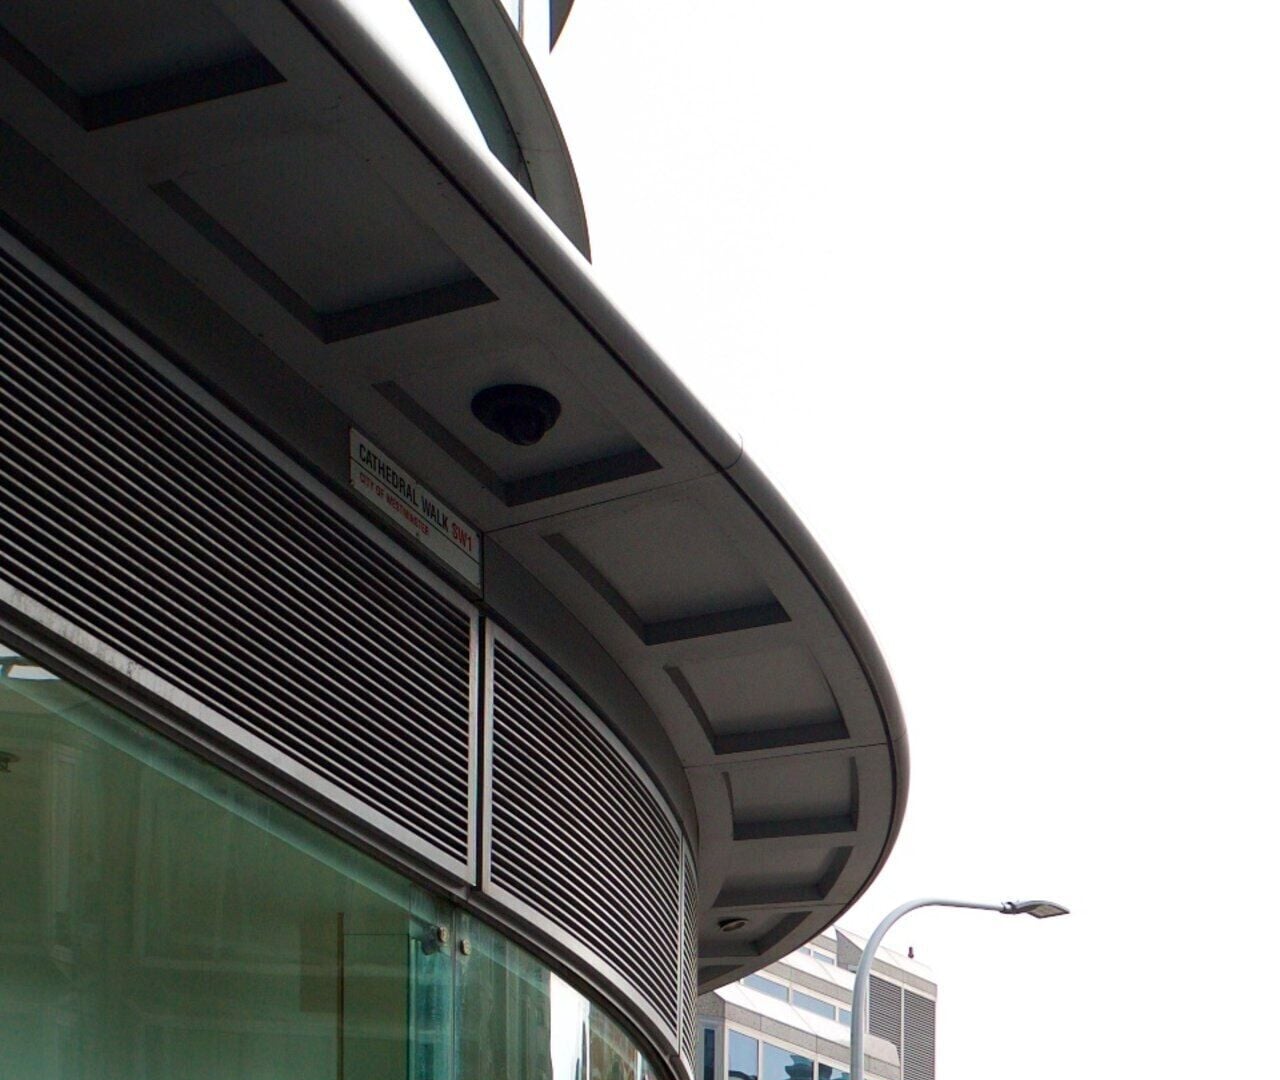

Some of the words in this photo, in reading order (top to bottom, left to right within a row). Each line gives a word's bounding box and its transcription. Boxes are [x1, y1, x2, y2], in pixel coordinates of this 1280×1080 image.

[358, 443, 419, 508] CATHEDRAL
[421, 495, 449, 534] WALK
[451, 522, 473, 552] SW1
[358, 472, 375, 492] CITY
[375, 486, 385, 497] OF
[386, 493, 430, 535] WESTMINSTER
